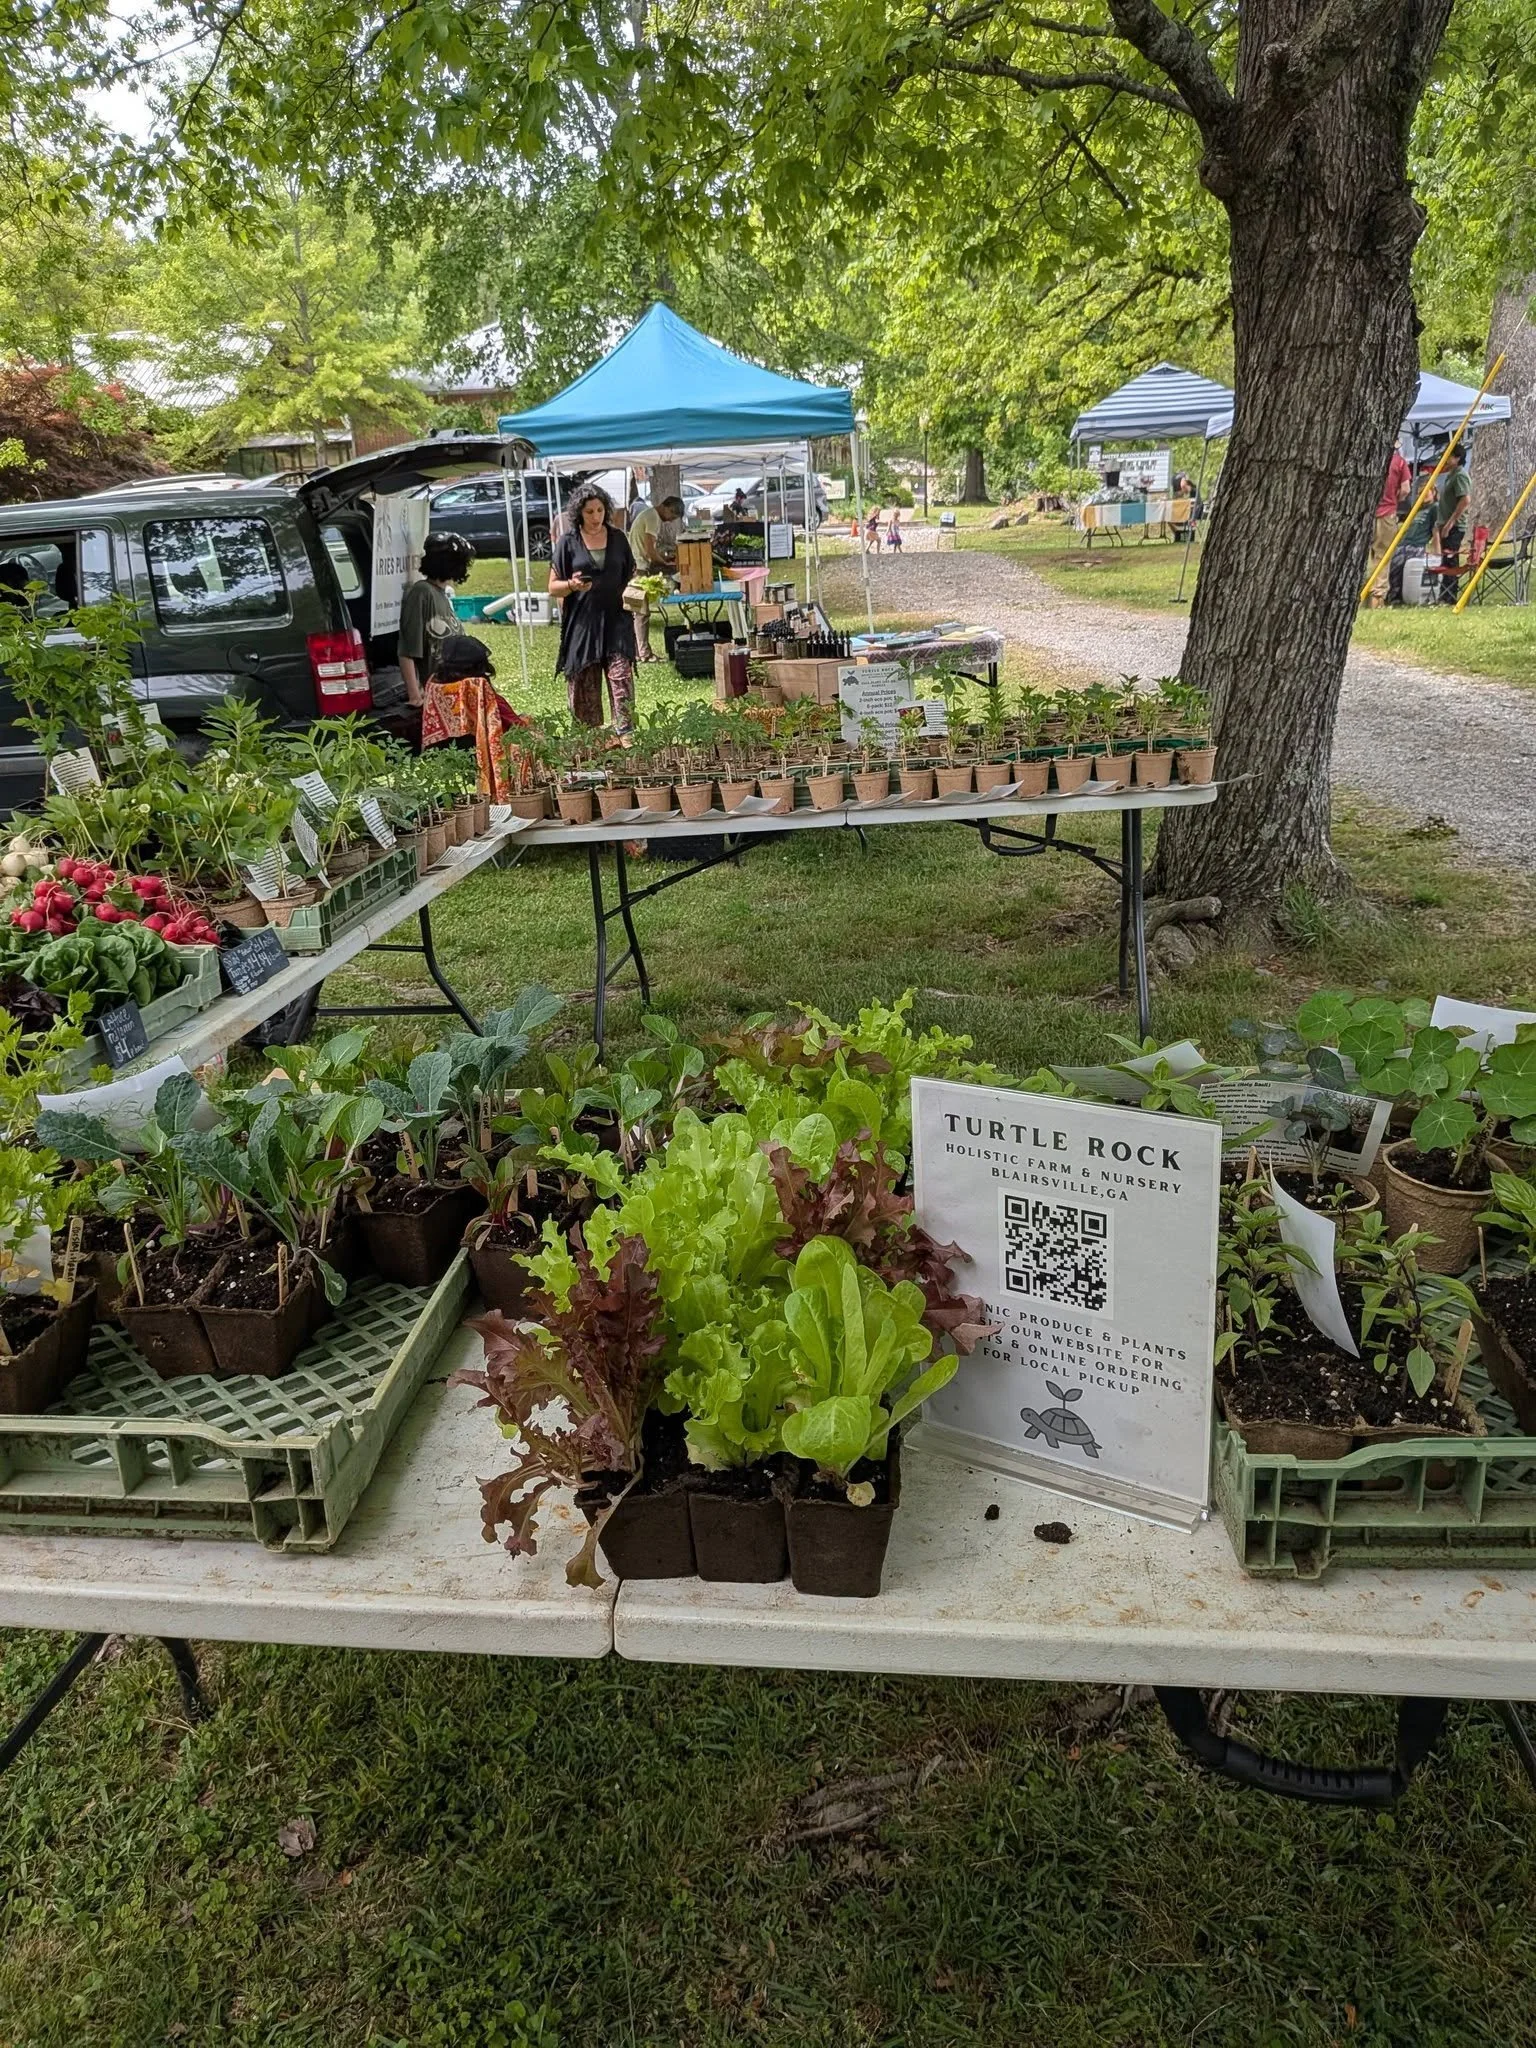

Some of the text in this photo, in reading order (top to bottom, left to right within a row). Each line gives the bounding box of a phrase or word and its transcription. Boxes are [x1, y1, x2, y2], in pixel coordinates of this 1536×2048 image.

[945, 1114, 1180, 1170] TURTLE ROCK
[947, 1144, 1181, 1193] HOLISTIC FARM & NURSERY
[1011, 1325, 1041, 1340] OUR
[1052, 1335, 1121, 1363] WEBSITE
[1133, 1355, 1162, 1370] FOR
[1020, 1312, 1092, 1340] PRODUCE
[1103, 1332, 1110, 1341] &
[1122, 1337, 1185, 1363] PLANTS
[983, 1347, 1139, 1394] FOR LOCAL PICKUP
[1011, 1340, 1019, 1349] &
[1028, 1341, 1085, 1368] ONLINE
[1096, 1361, 1181, 1394] ORDERING
